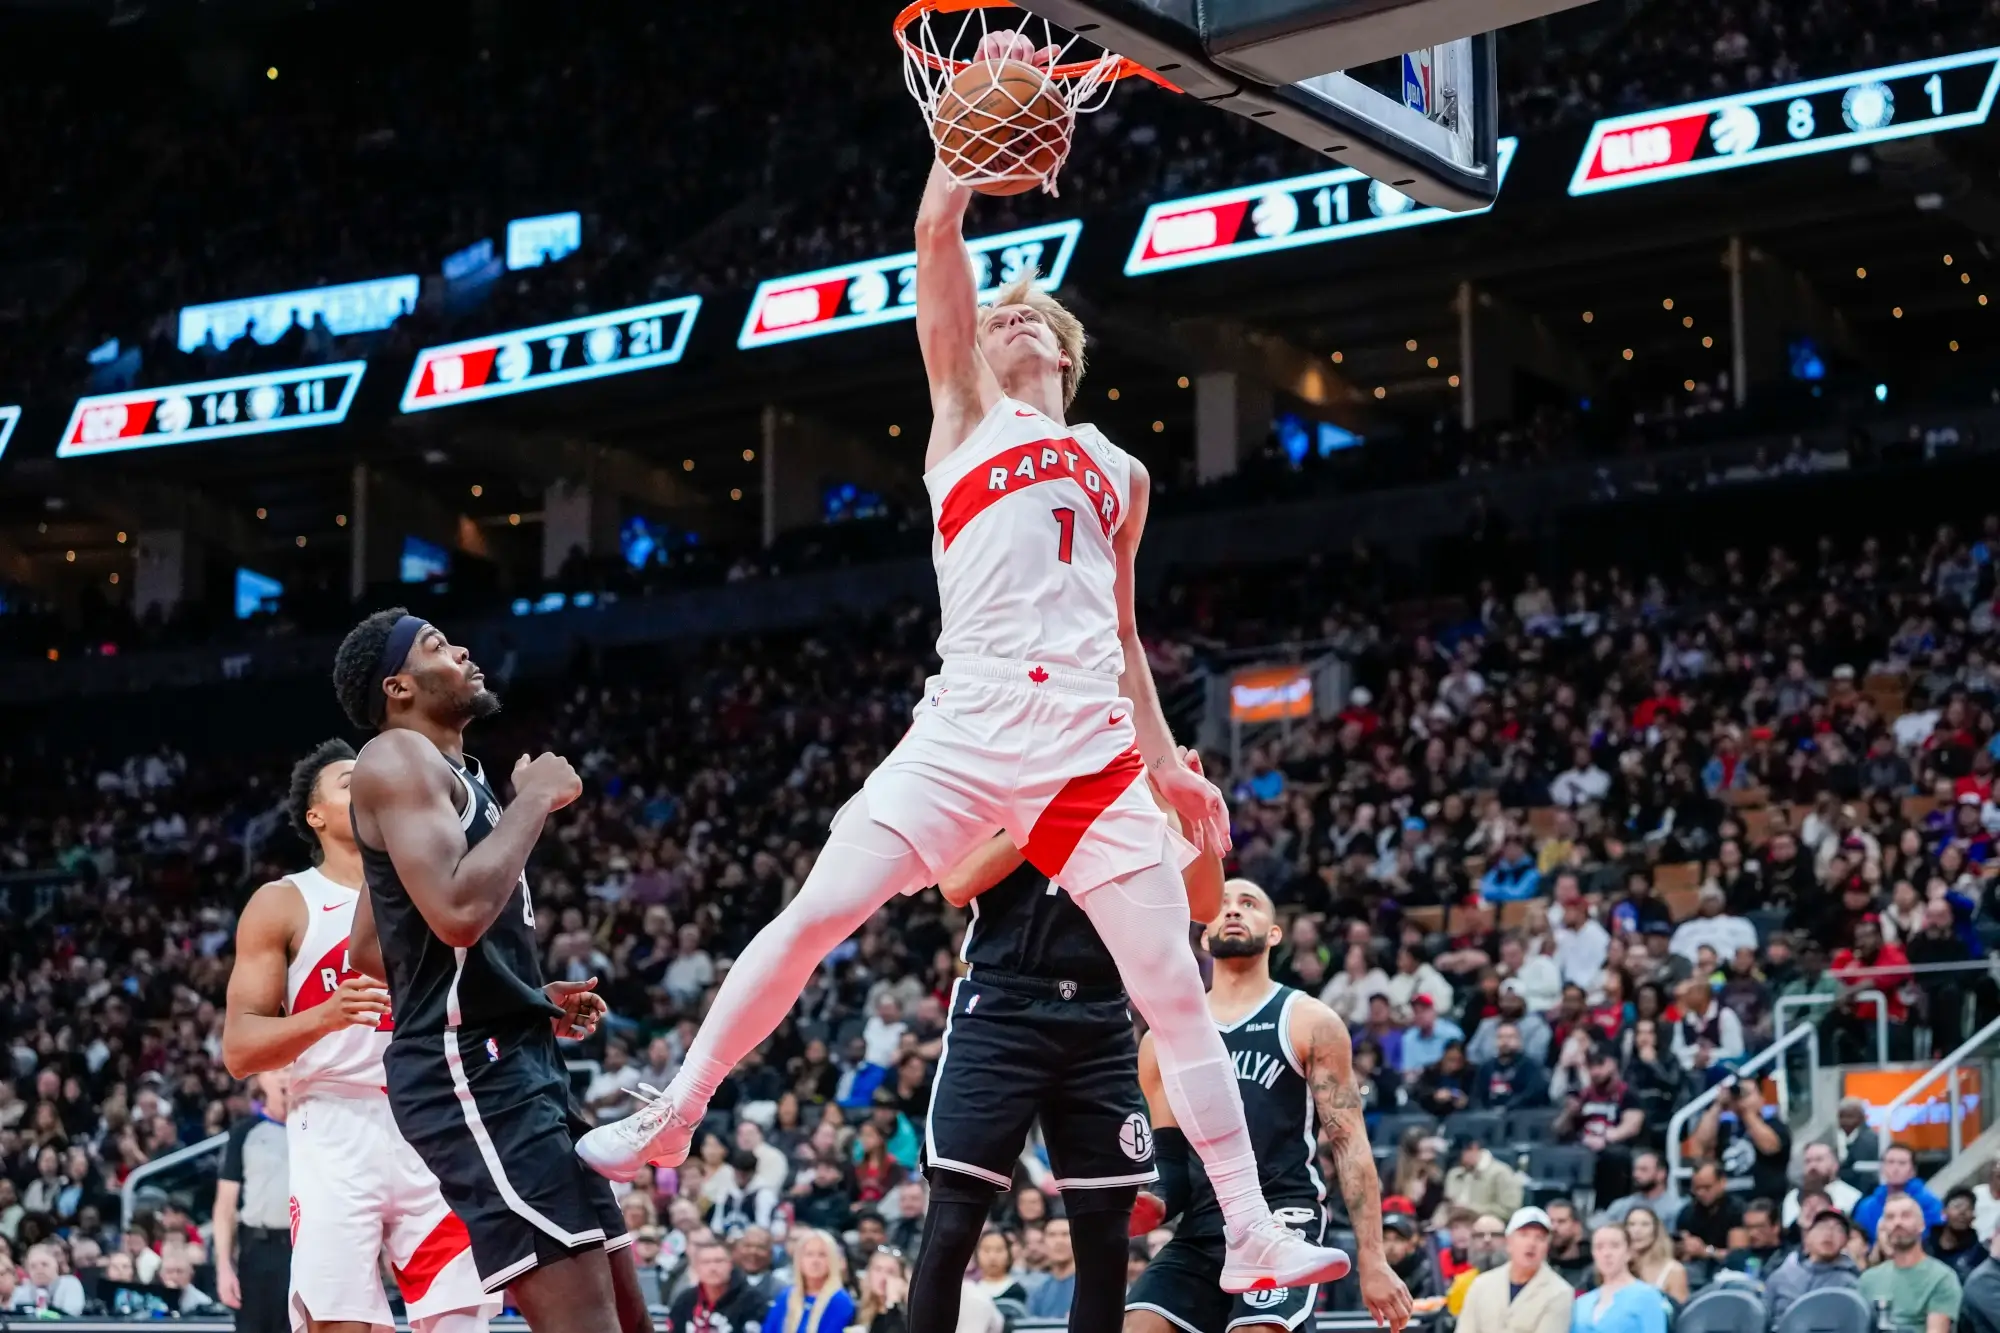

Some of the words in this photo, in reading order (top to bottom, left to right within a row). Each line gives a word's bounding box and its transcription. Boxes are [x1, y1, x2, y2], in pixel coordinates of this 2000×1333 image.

[1406, 81, 1421, 107] NBA
[1787, 98, 1815, 140] 8
[1924, 73, 1943, 116] 1
[1312, 184, 1349, 226] 11
[547, 335, 569, 372] 7
[628, 317, 663, 357] 21
[202, 392, 239, 426] 14
[295, 379, 325, 414] 11
[1051, 506, 1076, 565] 1
[1230, 1050, 1286, 1090] KLYN
[1133, 1119, 1146, 1155] B
